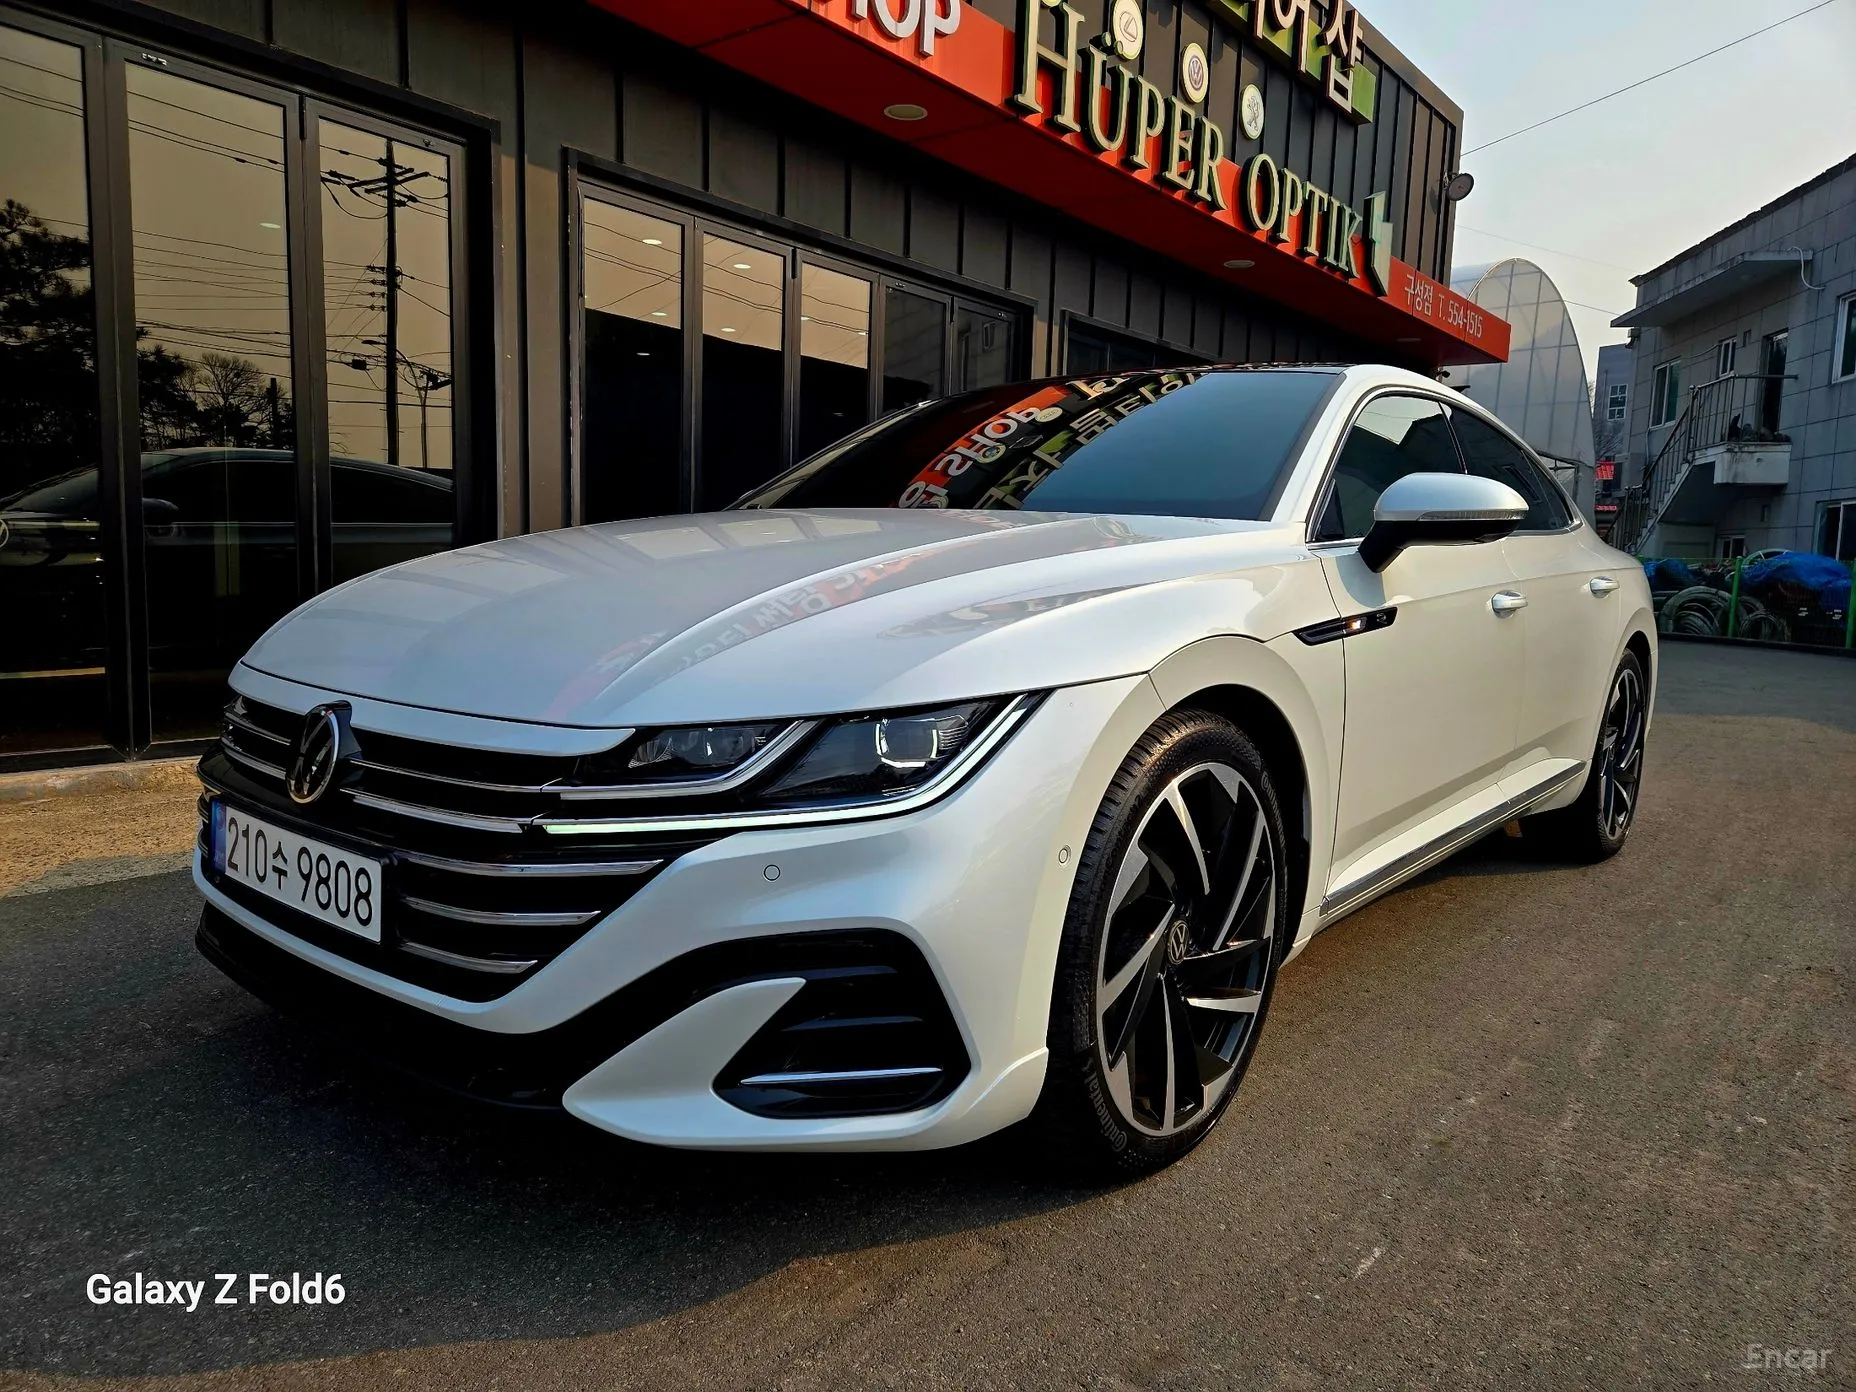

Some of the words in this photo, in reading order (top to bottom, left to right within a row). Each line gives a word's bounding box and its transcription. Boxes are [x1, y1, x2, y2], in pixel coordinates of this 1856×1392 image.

[1014, 0, 1228, 210] HÜPER
[1247, 153, 1363, 278] OPTIK
[1404, 274, 1433, 316] 구성점
[1083, 1070, 1128, 1152] Continental
